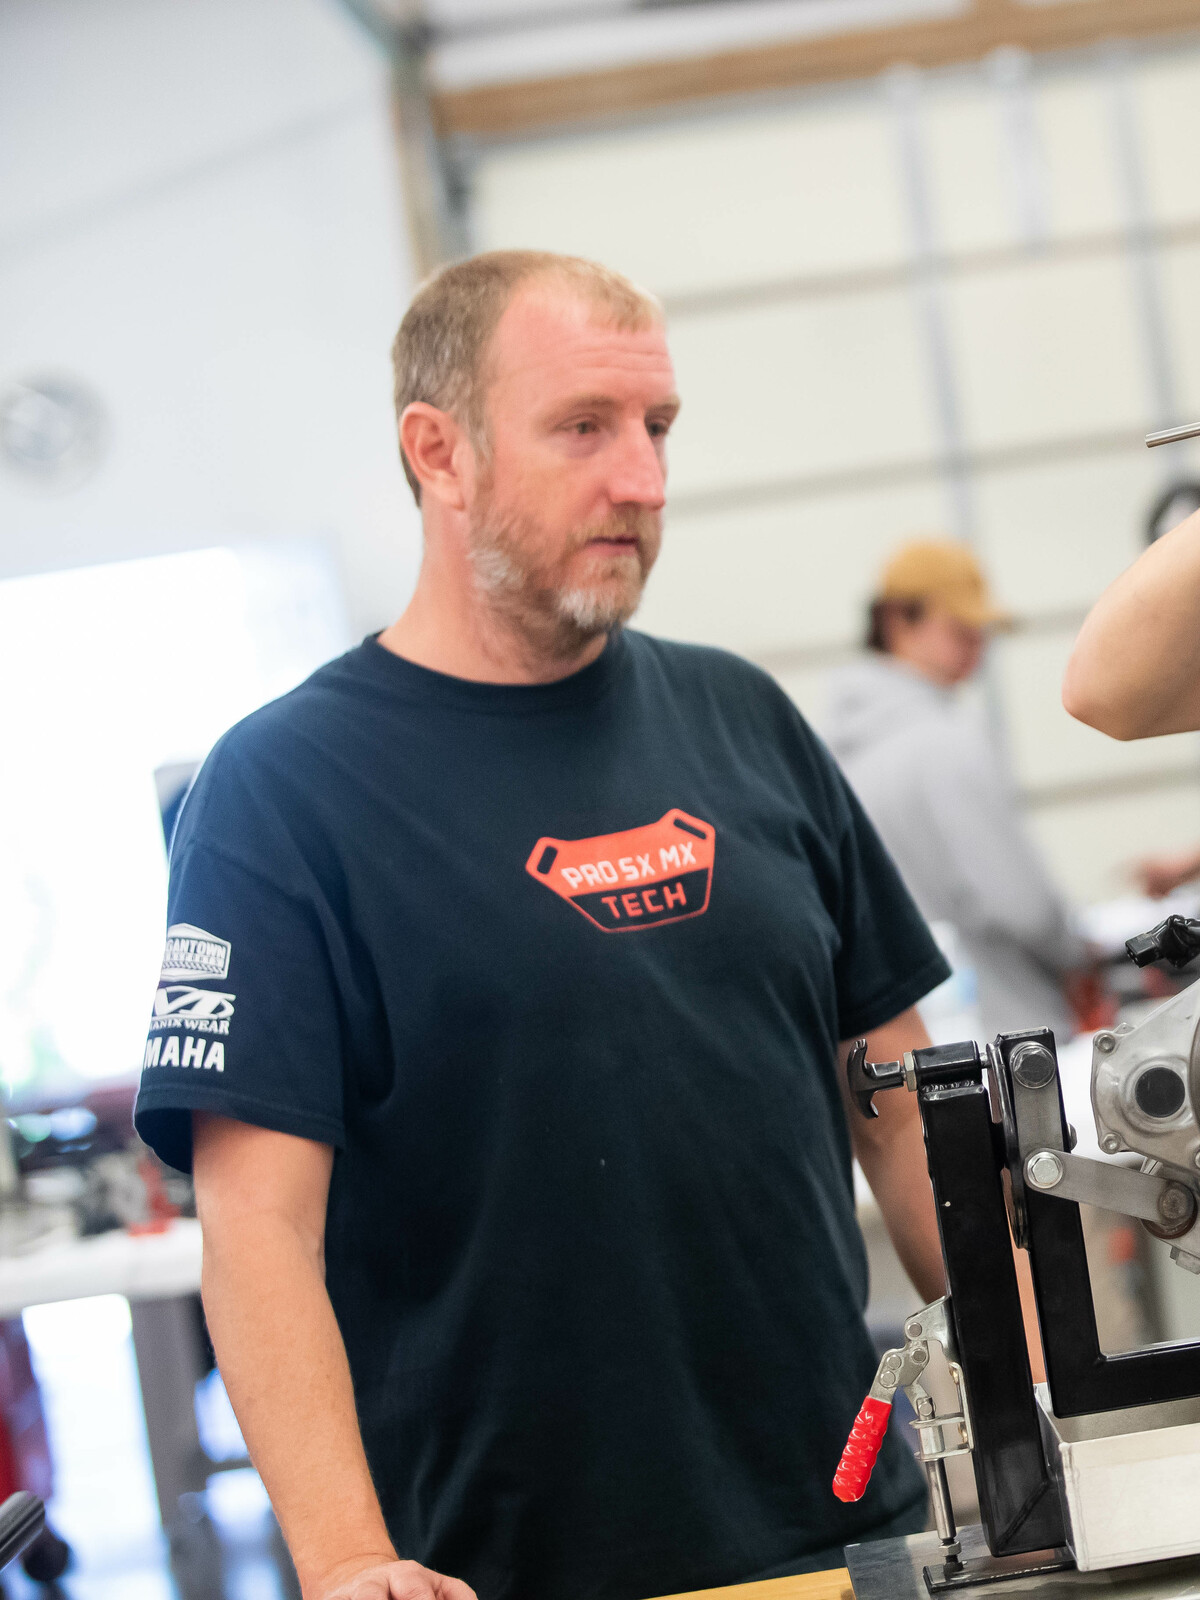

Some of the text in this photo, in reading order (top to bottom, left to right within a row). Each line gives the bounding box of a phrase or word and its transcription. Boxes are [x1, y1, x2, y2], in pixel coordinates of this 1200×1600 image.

[560, 841, 697, 890] PRO SX MX
[601, 882, 687, 919] TECH
[165, 938, 227, 959] GANTOWN
[150, 1019, 230, 1036] ANIX WEAR
[145, 1035, 225, 1073] MAHA
